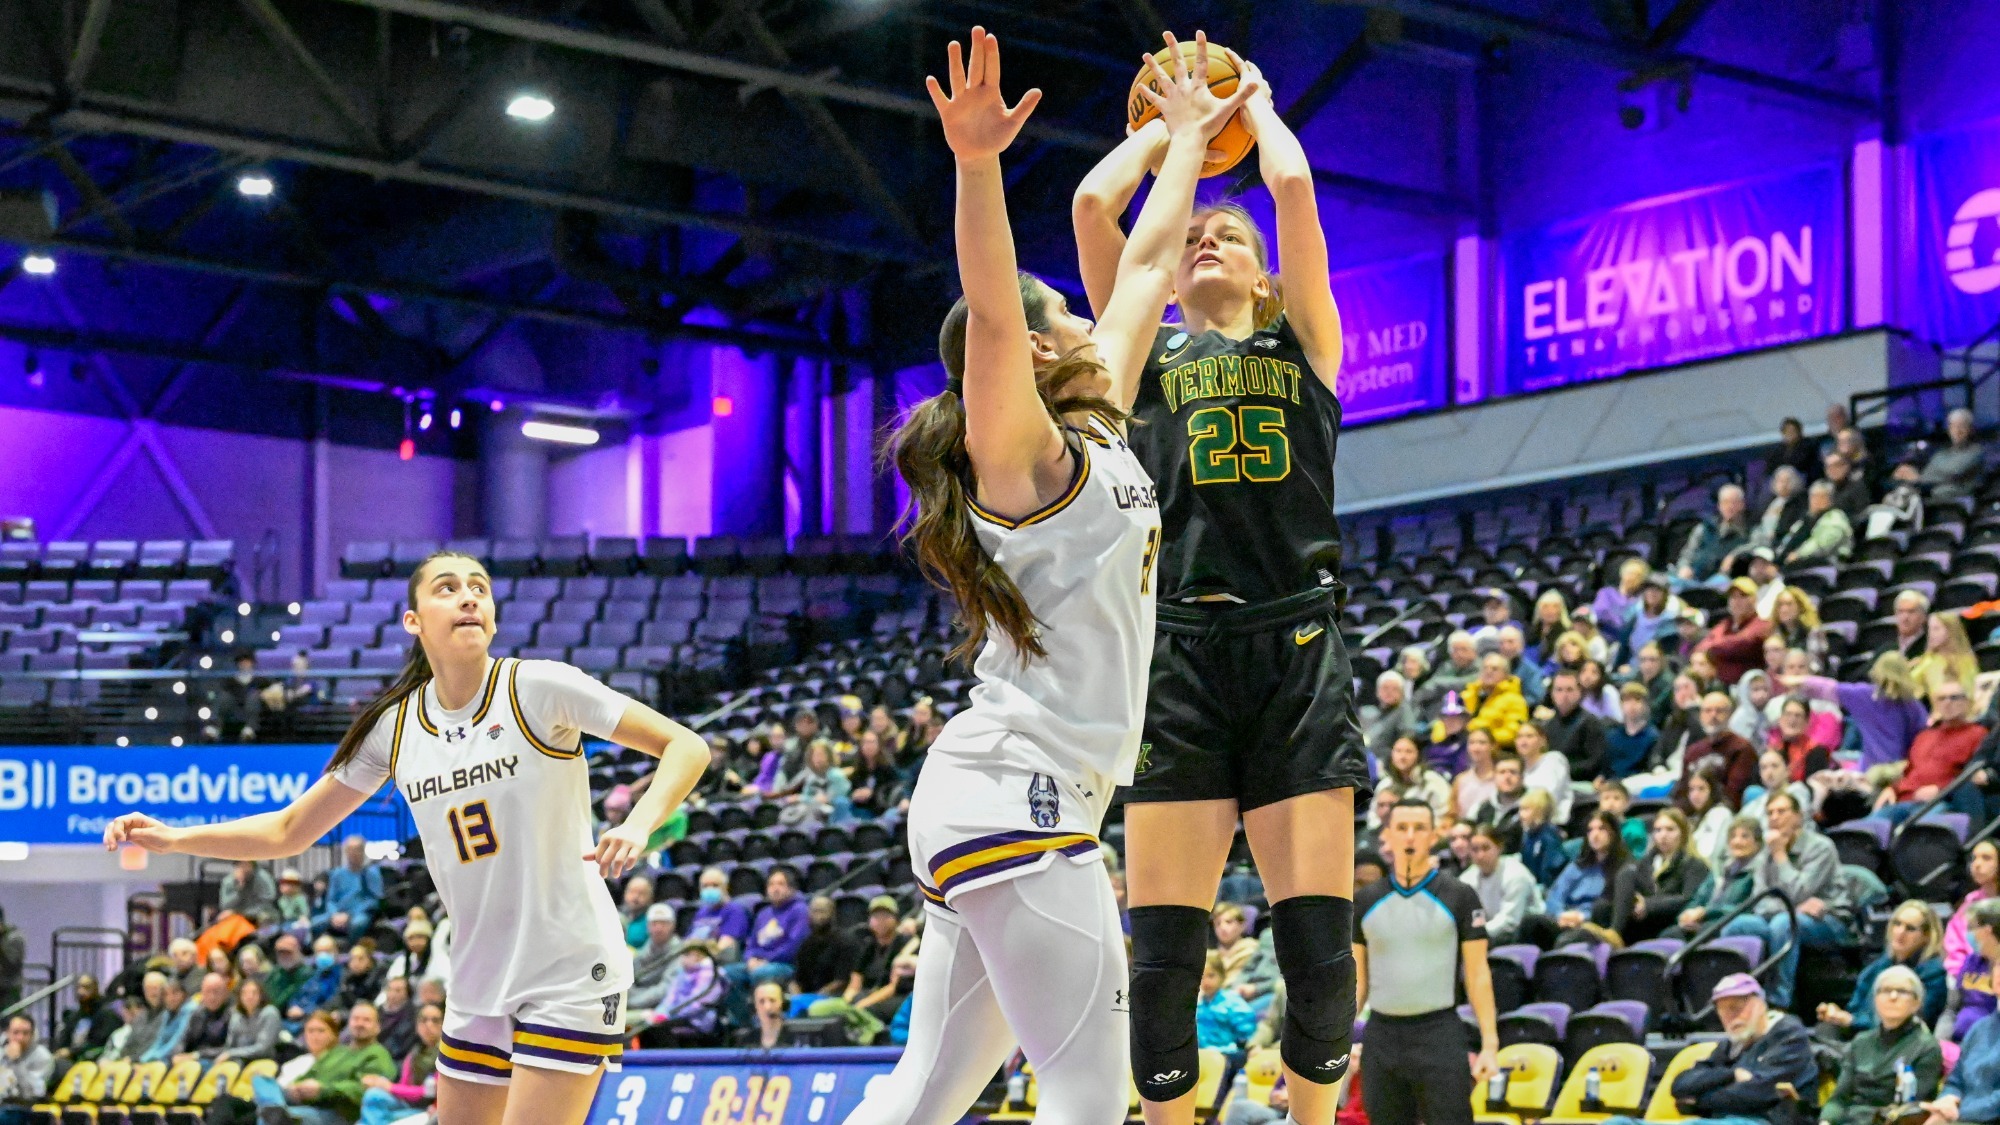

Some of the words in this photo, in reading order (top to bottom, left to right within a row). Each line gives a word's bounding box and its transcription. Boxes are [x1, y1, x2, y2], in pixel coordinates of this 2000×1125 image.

[1524, 226, 1812, 340] ELEVATION
[1159, 355, 1301, 413] VERMONT
[1187, 406, 1291, 485] 25
[67, 764, 308, 804] Broadview
[407, 755, 519, 803] UALBANY
[446, 799, 500, 864] 13
[702, 1075, 792, 1125] 8:19
